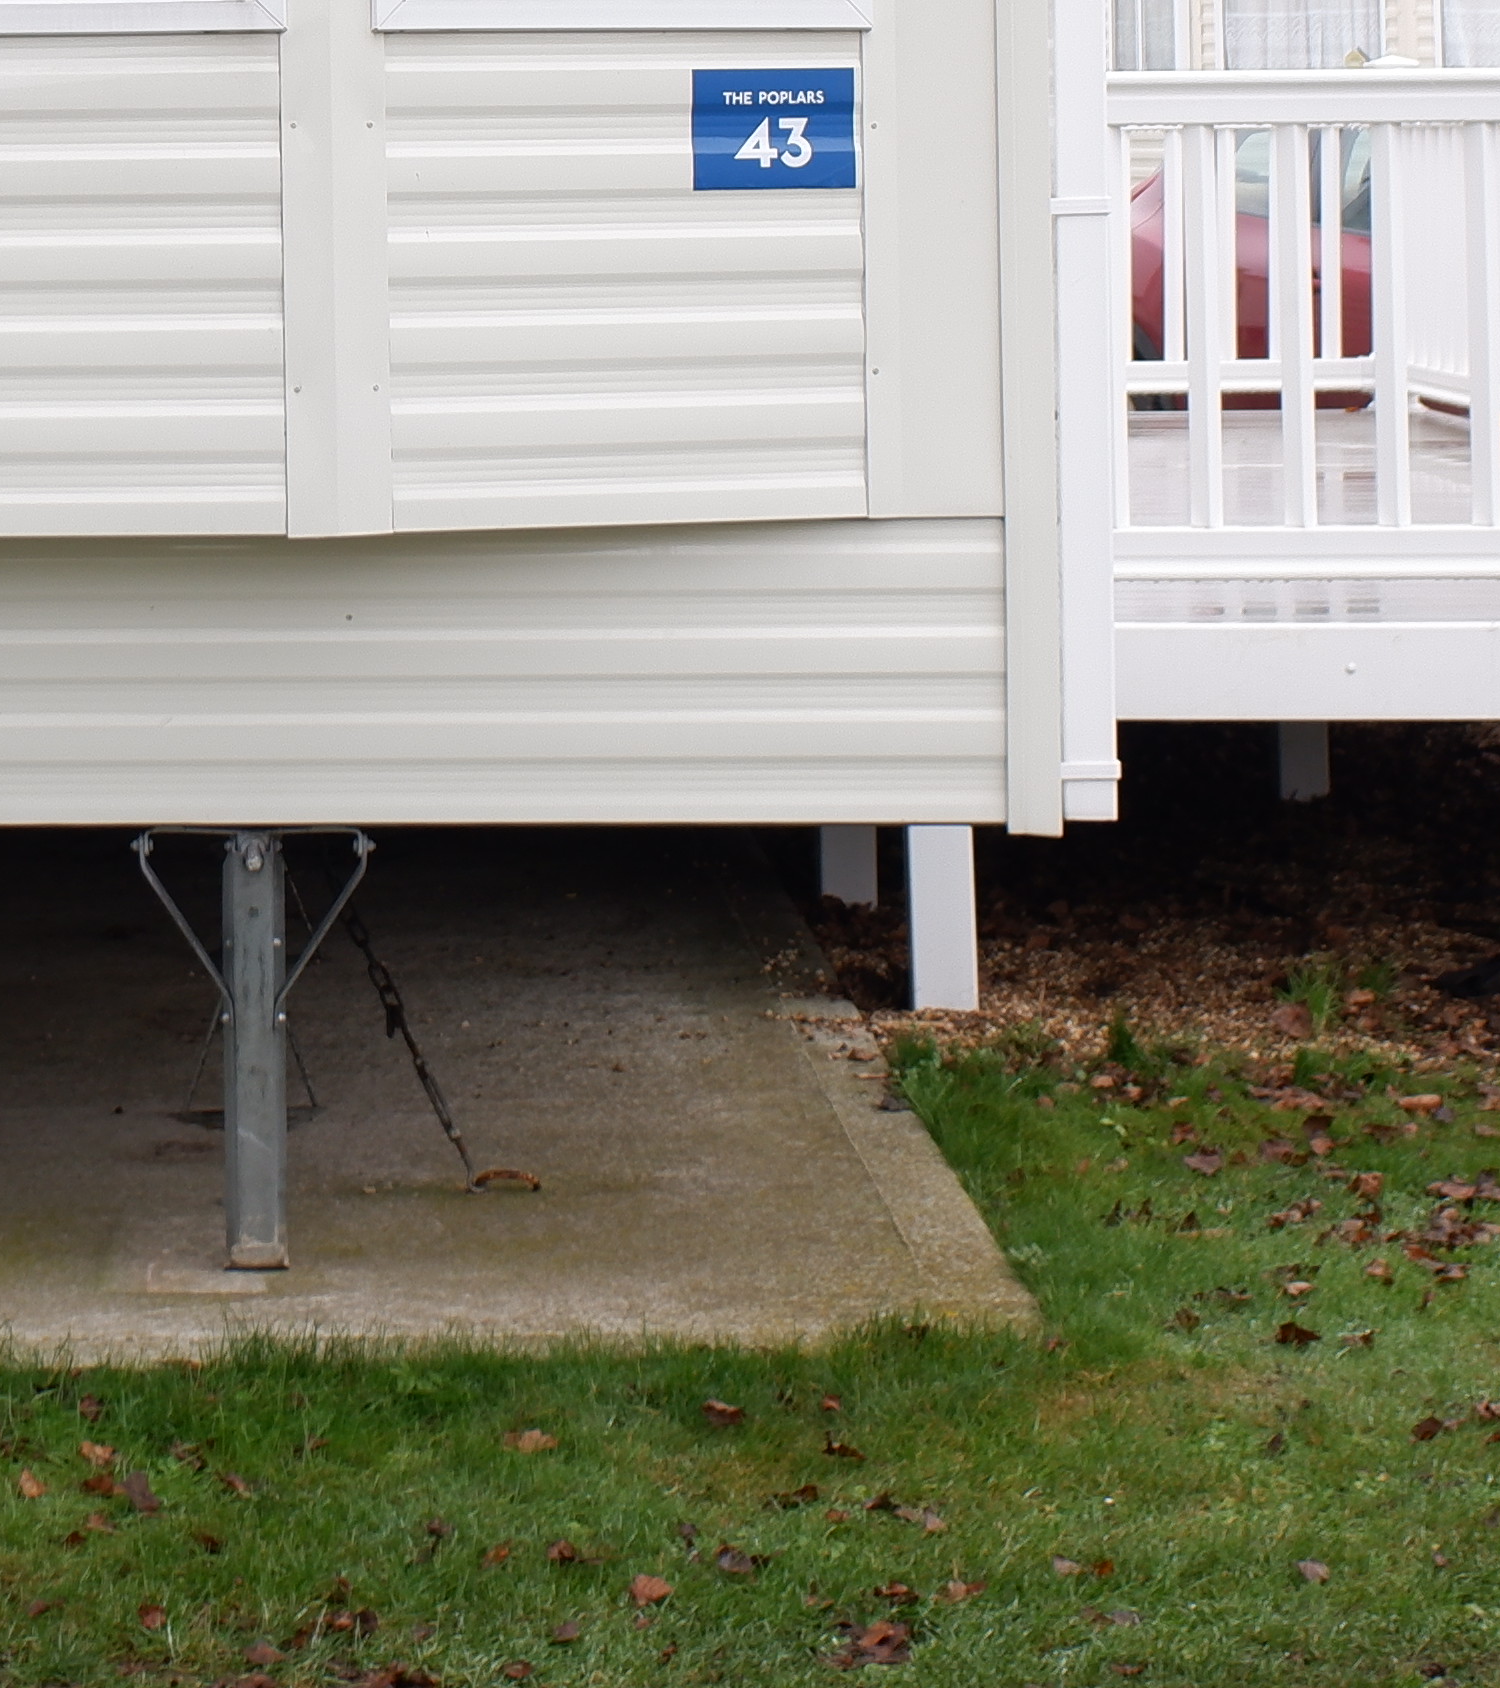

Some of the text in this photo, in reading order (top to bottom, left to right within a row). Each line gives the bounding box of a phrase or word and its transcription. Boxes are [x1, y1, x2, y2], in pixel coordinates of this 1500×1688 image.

[723, 90, 825, 105] THE POPLARS
[734, 116, 813, 168] 43
